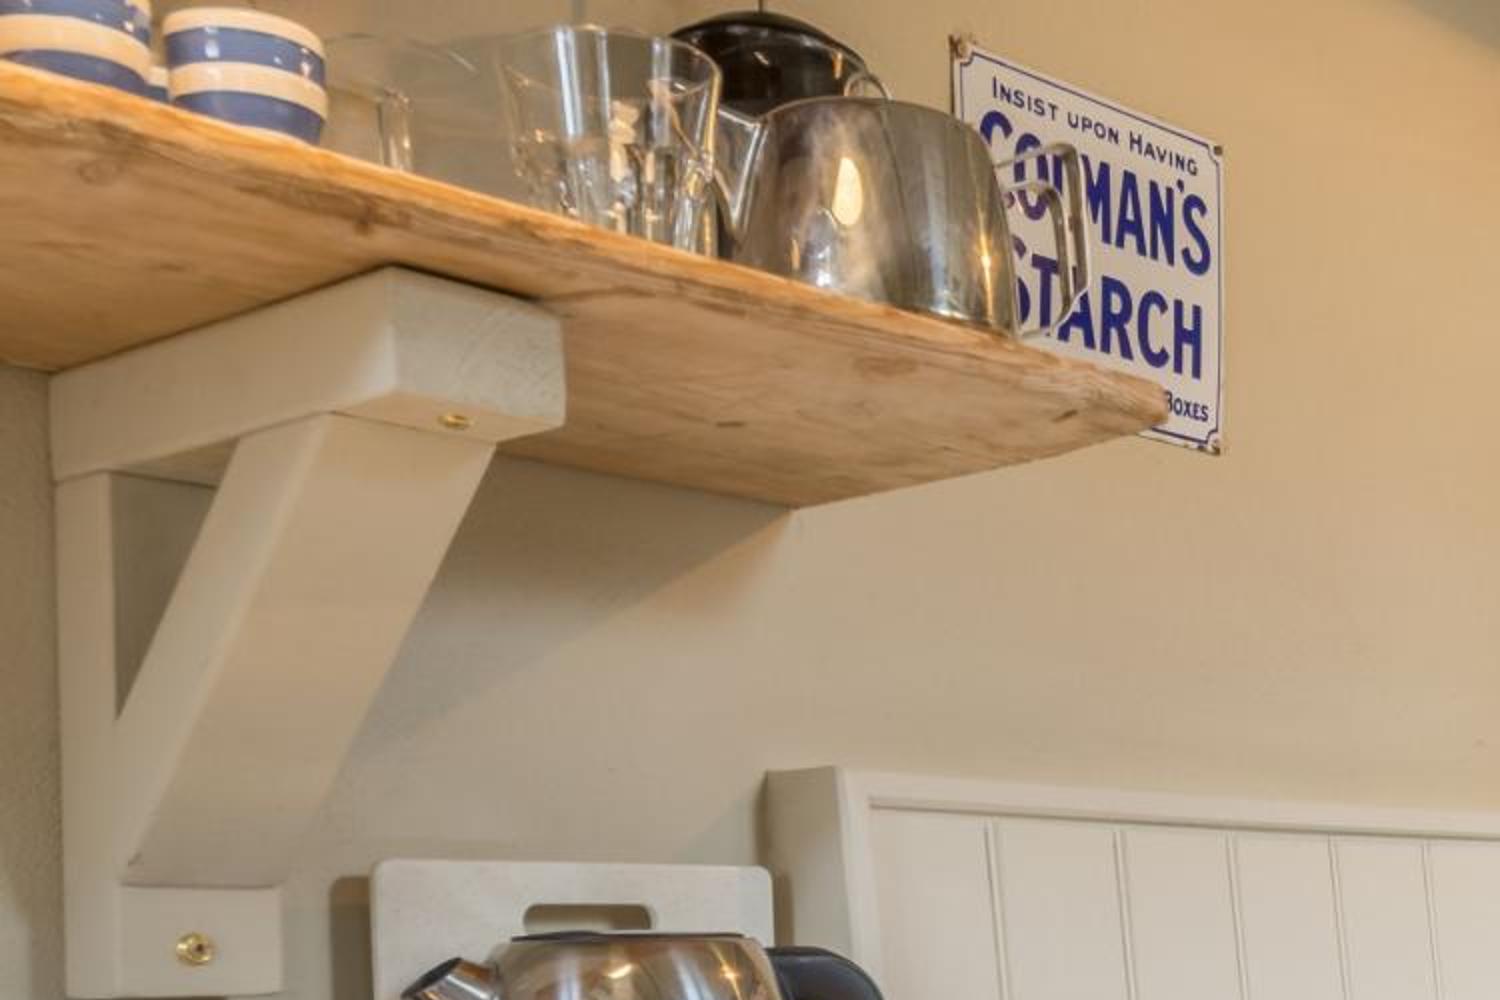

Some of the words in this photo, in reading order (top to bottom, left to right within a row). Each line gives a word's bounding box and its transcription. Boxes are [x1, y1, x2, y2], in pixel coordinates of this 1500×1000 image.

[991, 76, 1058, 121] INSIST
[1067, 111, 1119, 145] UPON
[1130, 131, 1198, 176] HAVING
